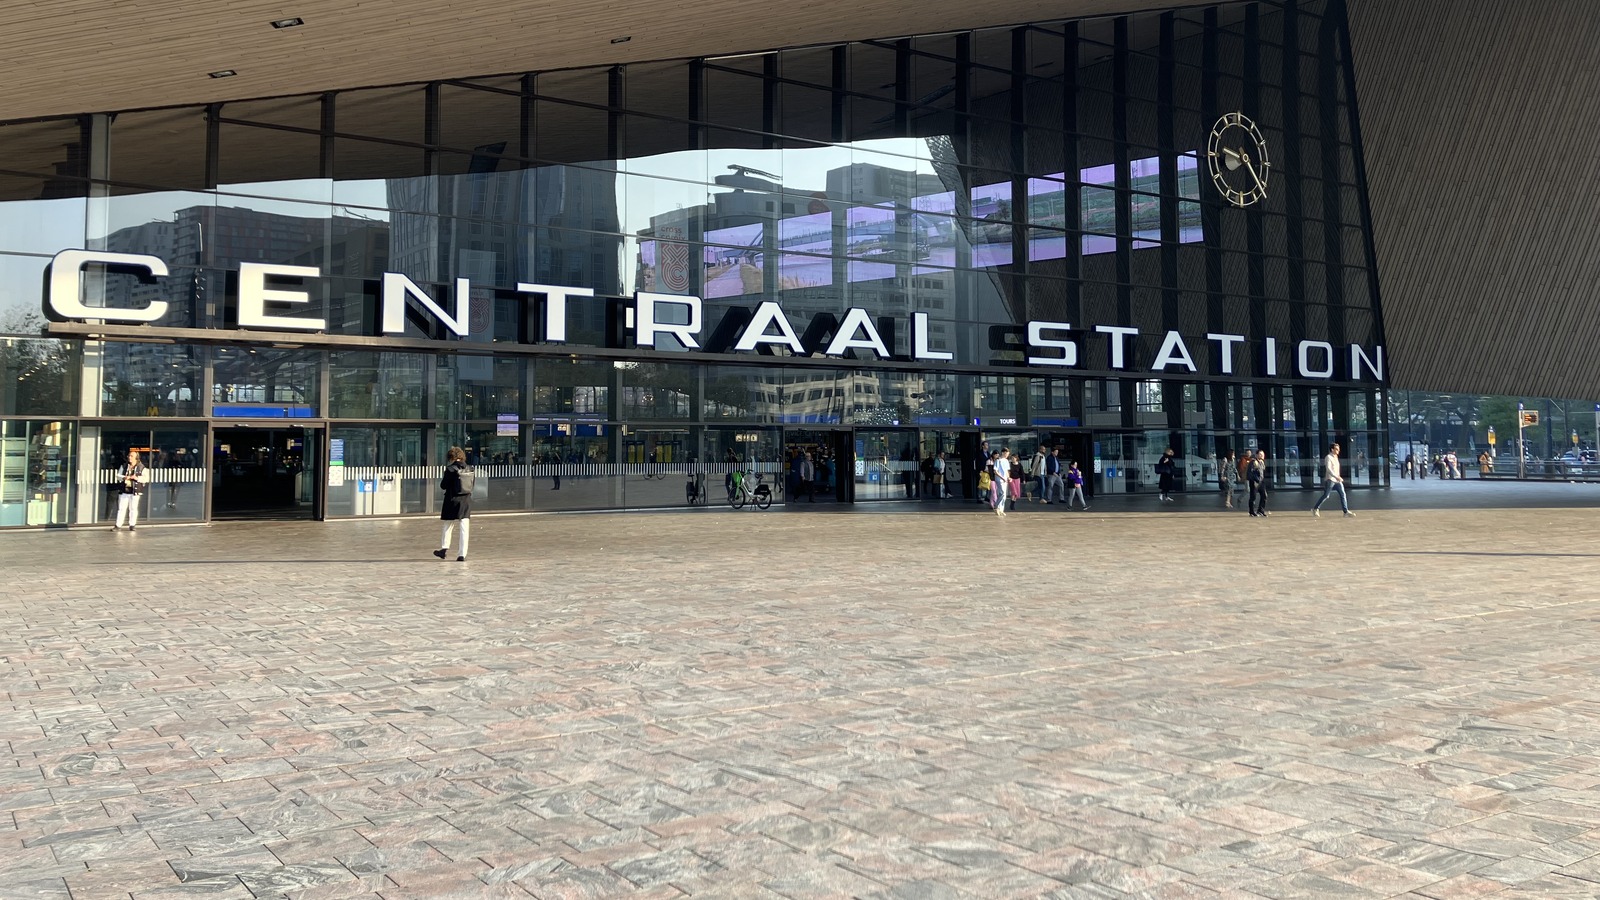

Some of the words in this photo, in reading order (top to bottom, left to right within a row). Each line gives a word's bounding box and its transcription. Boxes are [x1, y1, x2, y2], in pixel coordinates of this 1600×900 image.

[661, 226, 682, 234] cross
[48, 248, 954, 361] CENTRAAL
[1027, 320, 1383, 381] STATION
